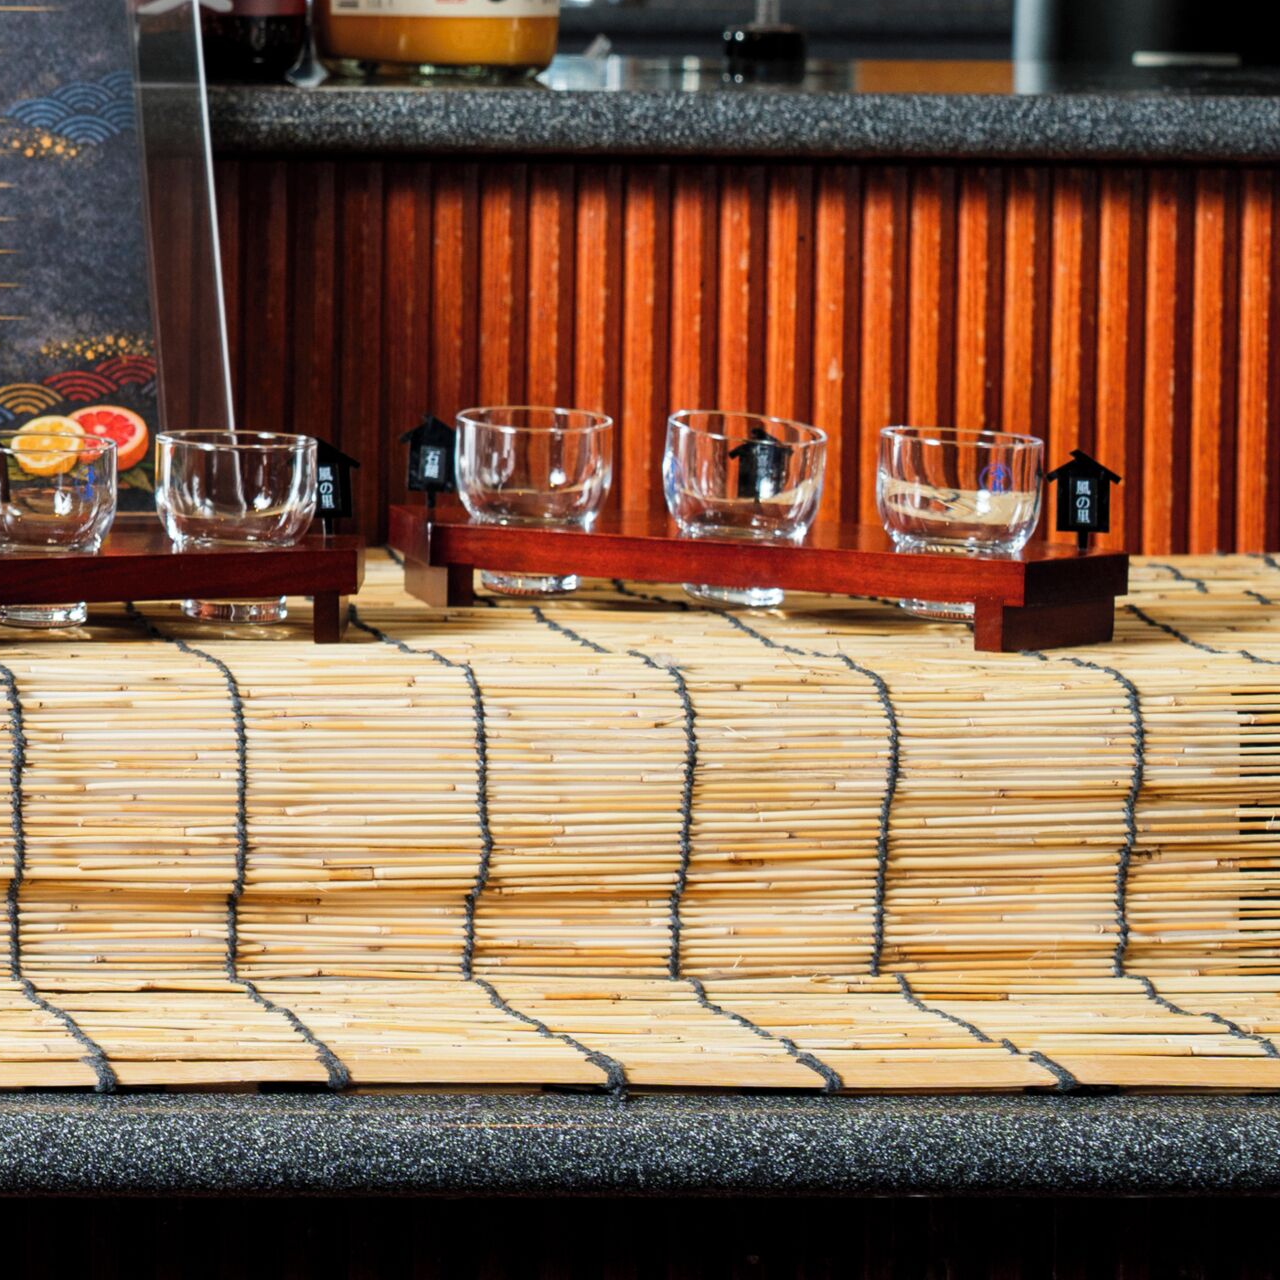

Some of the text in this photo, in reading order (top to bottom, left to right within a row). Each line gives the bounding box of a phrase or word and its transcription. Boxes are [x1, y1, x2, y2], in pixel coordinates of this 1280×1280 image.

[318, 466, 335, 509] 風の里
[1075, 479, 1092, 524] 風の里
